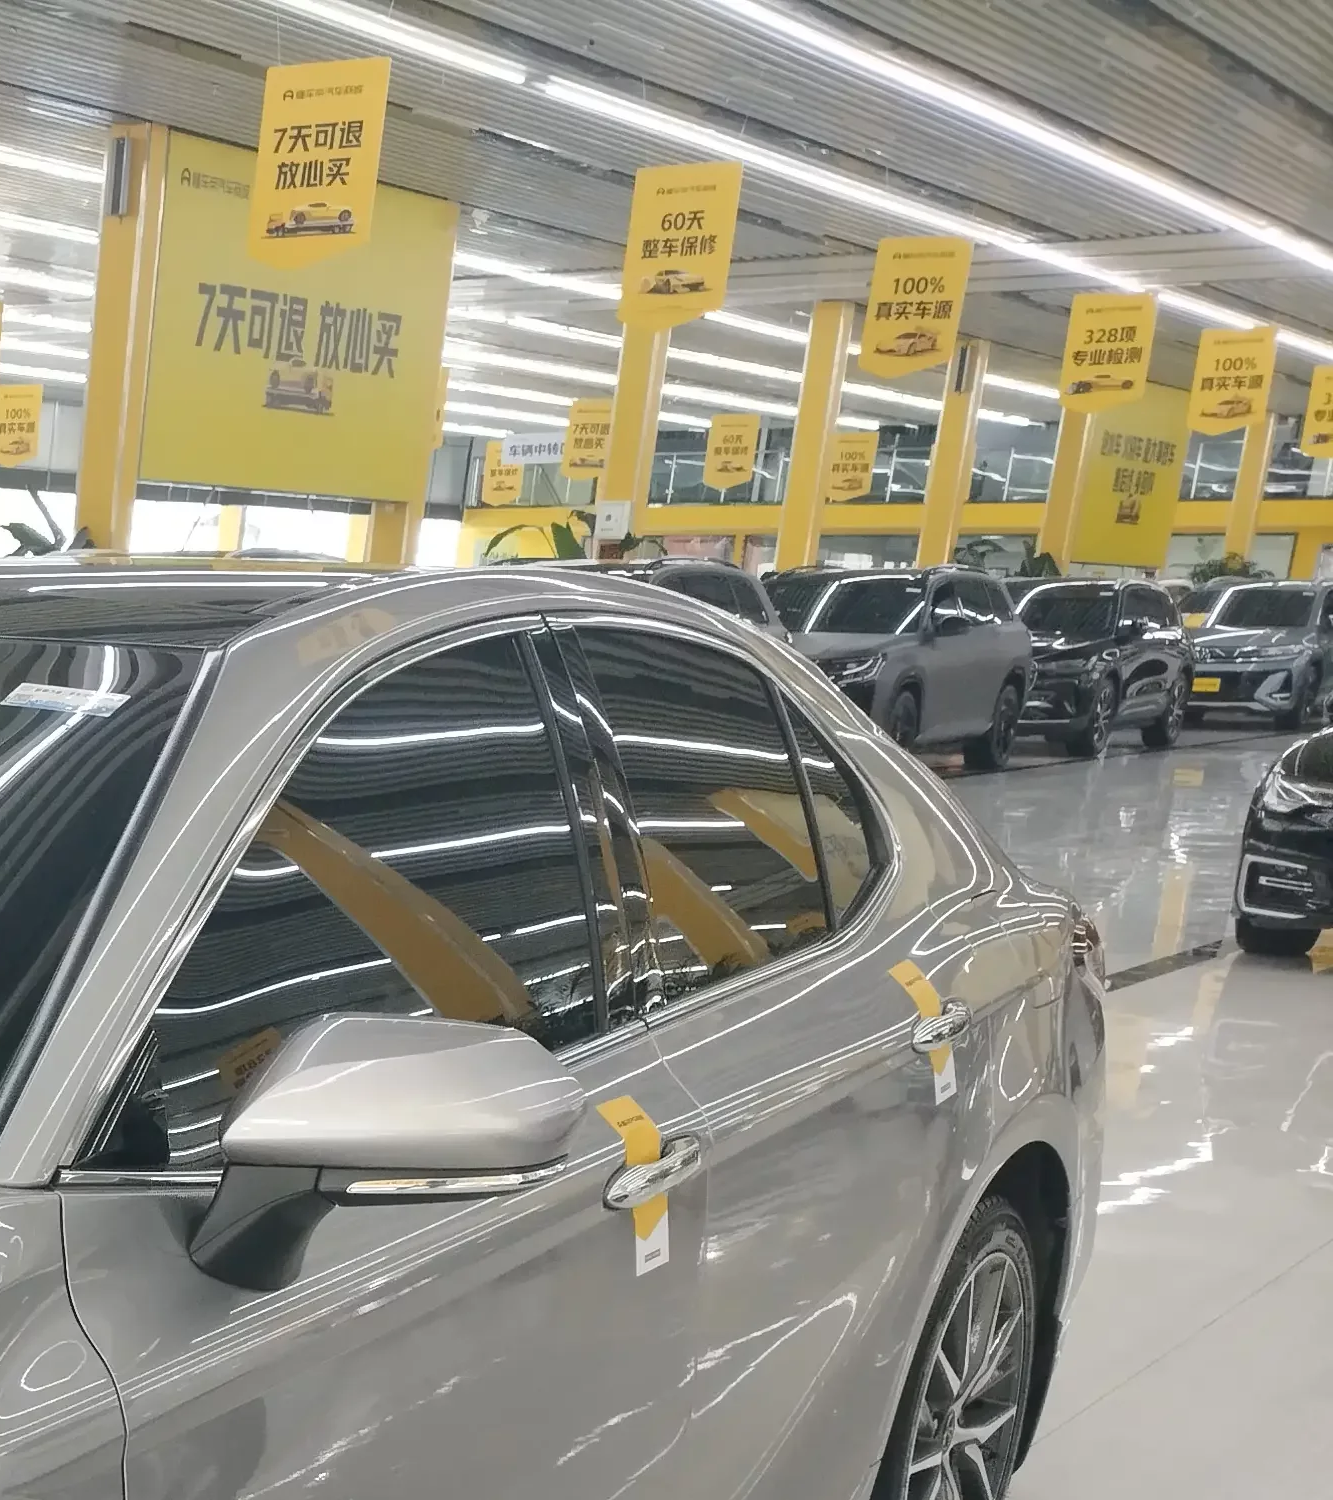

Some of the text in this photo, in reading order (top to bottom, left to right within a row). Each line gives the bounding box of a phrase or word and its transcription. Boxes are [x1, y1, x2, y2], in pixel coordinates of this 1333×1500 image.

[273, 119, 364, 154] 7天可退
[274, 157, 352, 190] 放心买
[661, 209, 705, 232] 60天
[641, 234, 718, 260] 整车保修
[893, 276, 945, 295] 100%
[875, 300, 954, 321] 真实车源
[195, 282, 402, 379] 7天可退 放心买
[1084, 326, 1138, 345] 328项
[1071, 346, 1143, 367] 专业检测
[1214, 357, 1258, 372] 100%
[4, 408, 32, 420] 100%
